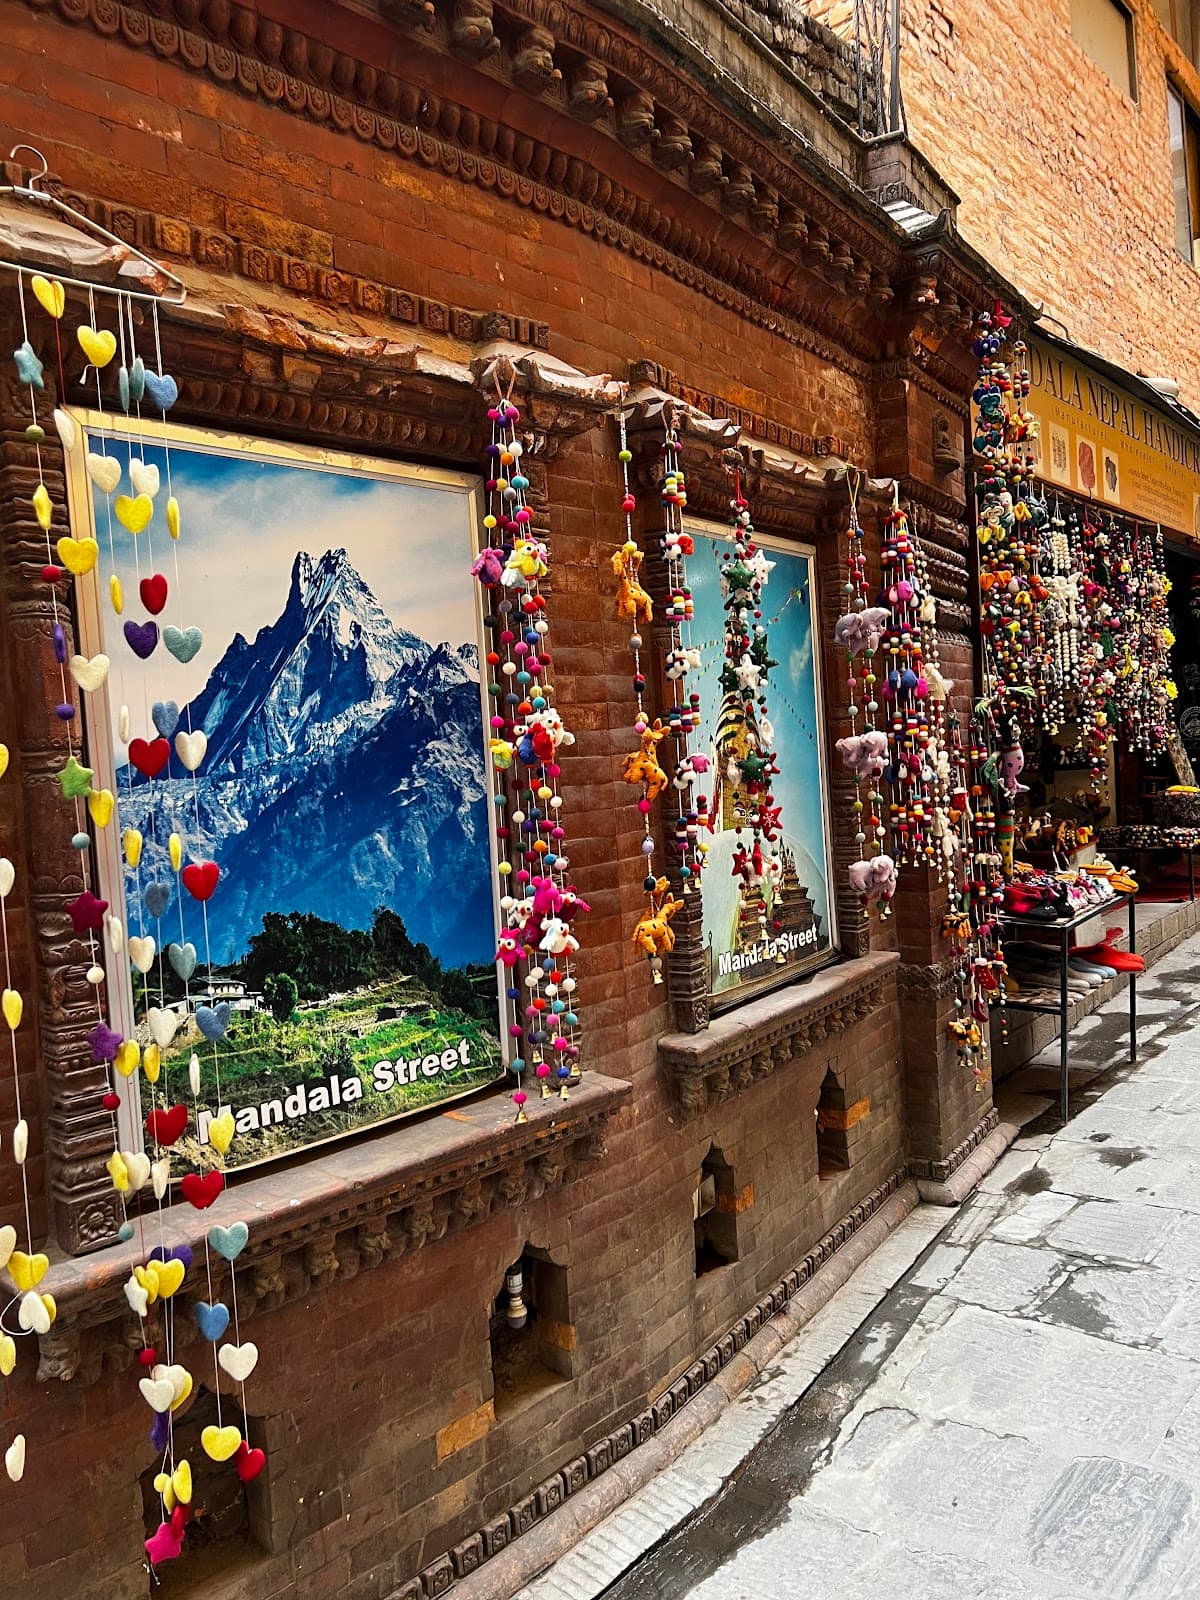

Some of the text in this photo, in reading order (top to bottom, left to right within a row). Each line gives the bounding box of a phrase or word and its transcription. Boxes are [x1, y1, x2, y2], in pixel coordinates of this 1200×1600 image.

[1026, 342, 1083, 411] DALA
[1087, 374, 1140, 441] NEPAL
[780, 922, 818, 953] Street
[371, 1038, 471, 1092] Street
